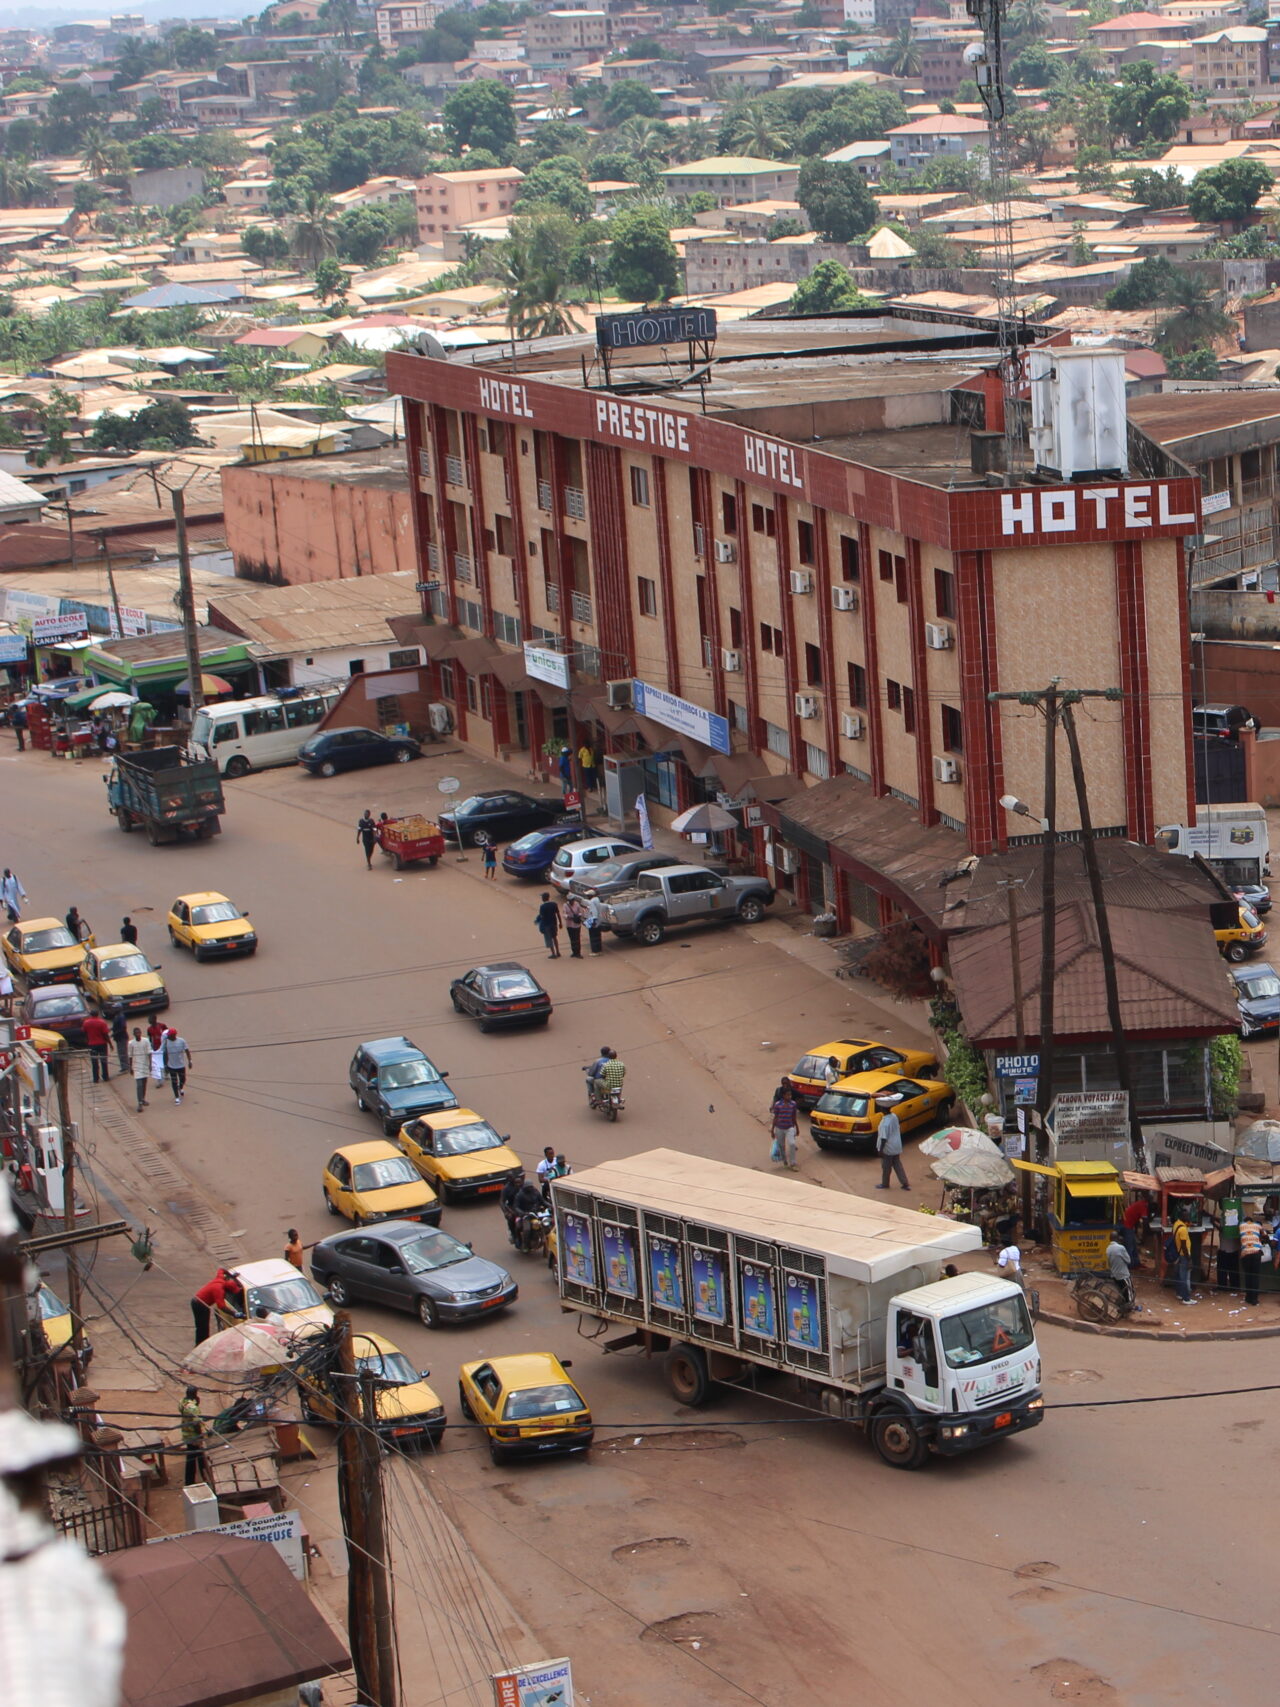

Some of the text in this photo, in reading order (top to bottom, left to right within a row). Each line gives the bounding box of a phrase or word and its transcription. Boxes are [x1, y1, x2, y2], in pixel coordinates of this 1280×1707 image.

[612, 312, 715, 346] HOTEL
[479, 377, 534, 418] HOTEL
[596, 399, 690, 452] PRESTIGE
[743, 434, 803, 488] HOTEL
[1001, 484, 1195, 535] HOTEL
[34, 614, 85, 627] AUTO ECOLE
[996, 1054, 1039, 1069] PHOTO
[1001, 1066, 1033, 1075] MINUTE
[1165, 1138, 1218, 1163] EXPRESS UNION
[991, 1360, 1010, 1371] IVECO
[245, 1513, 288, 1526] Yaoundé
[253, 1519, 294, 1533] Mendong
